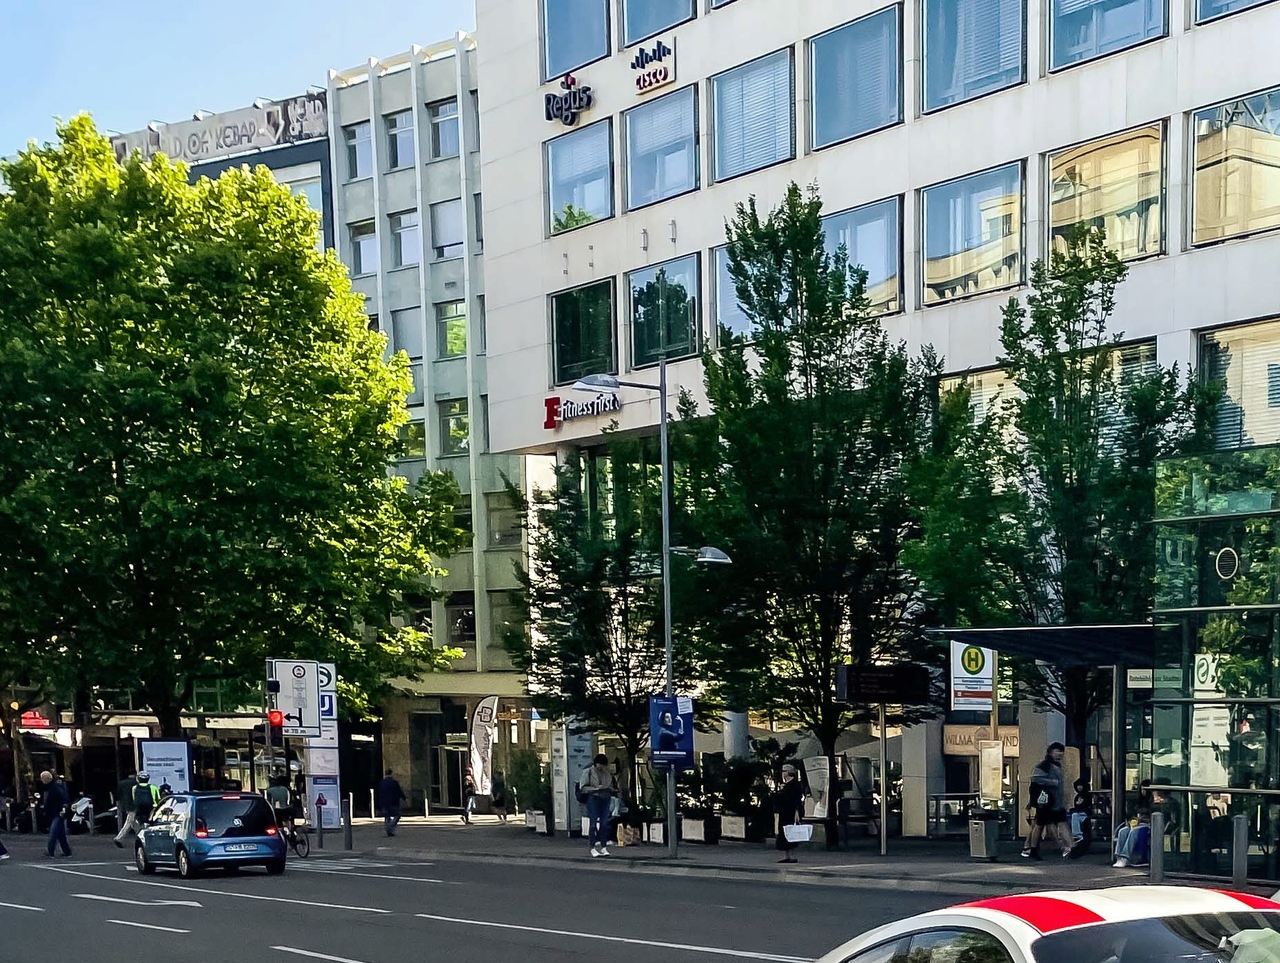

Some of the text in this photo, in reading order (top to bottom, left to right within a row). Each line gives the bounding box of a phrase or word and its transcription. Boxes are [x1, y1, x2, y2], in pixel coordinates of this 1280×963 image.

[545, 86, 592, 126] Regus
[967, 650, 979, 668] H
[945, 734, 973, 746] WILMA
